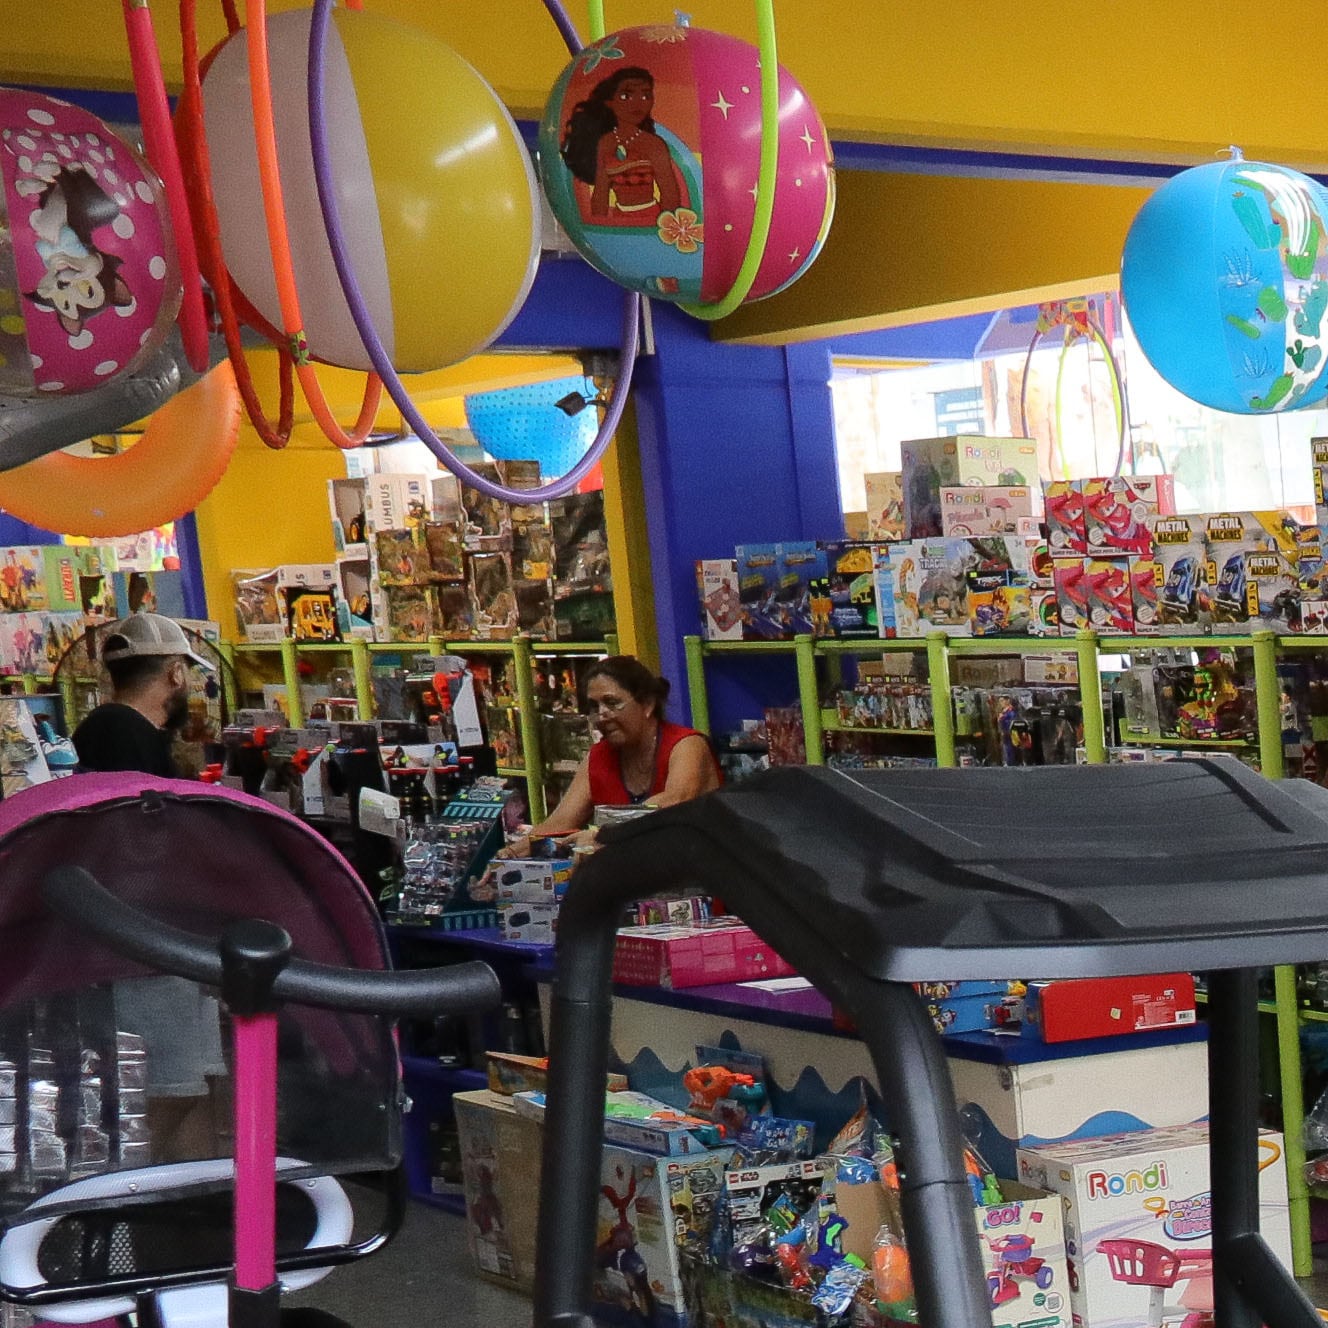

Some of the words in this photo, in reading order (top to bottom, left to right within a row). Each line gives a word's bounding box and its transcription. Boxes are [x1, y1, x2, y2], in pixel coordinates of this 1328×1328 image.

[1158, 520, 1188, 531] METAL
[1210, 517, 1241, 529] METAL
[1160, 531, 1189, 542] MACHINES
[1210, 529, 1242, 540] MACHINES
[1250, 556, 1278, 566] METAL
[1087, 1160, 1169, 1198] Rondi
[987, 1205, 1021, 1229] GO!
